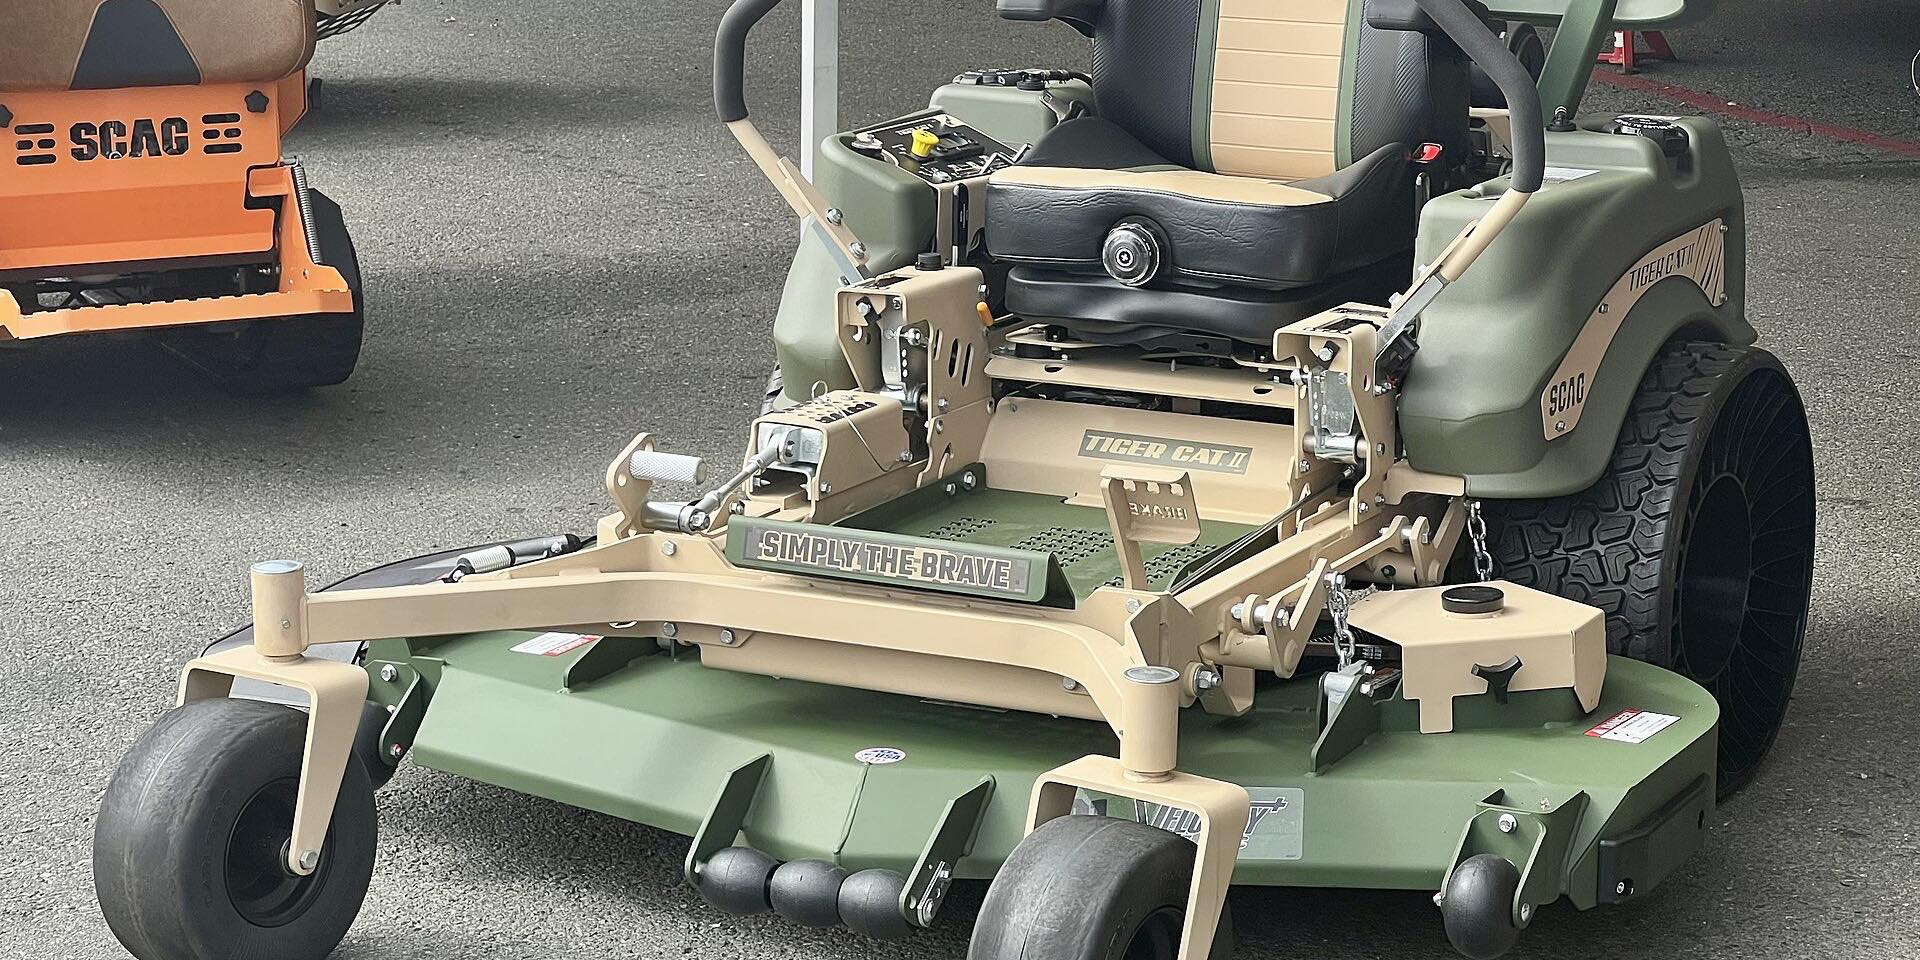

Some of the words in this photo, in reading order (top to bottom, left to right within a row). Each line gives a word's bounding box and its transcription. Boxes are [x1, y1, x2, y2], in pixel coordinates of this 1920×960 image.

[69, 117, 189, 161] SCAG
[1630, 257, 1665, 291] TIGER
[1549, 372, 1584, 416] SCAG
[1085, 435, 1167, 459] TIGER
[1171, 445, 1230, 466] CAT
[1228, 452, 1248, 468] II
[763, 531, 860, 569] SIMPLY
[864, 544, 914, 576] THE
[920, 551, 1011, 589] BRAVE
